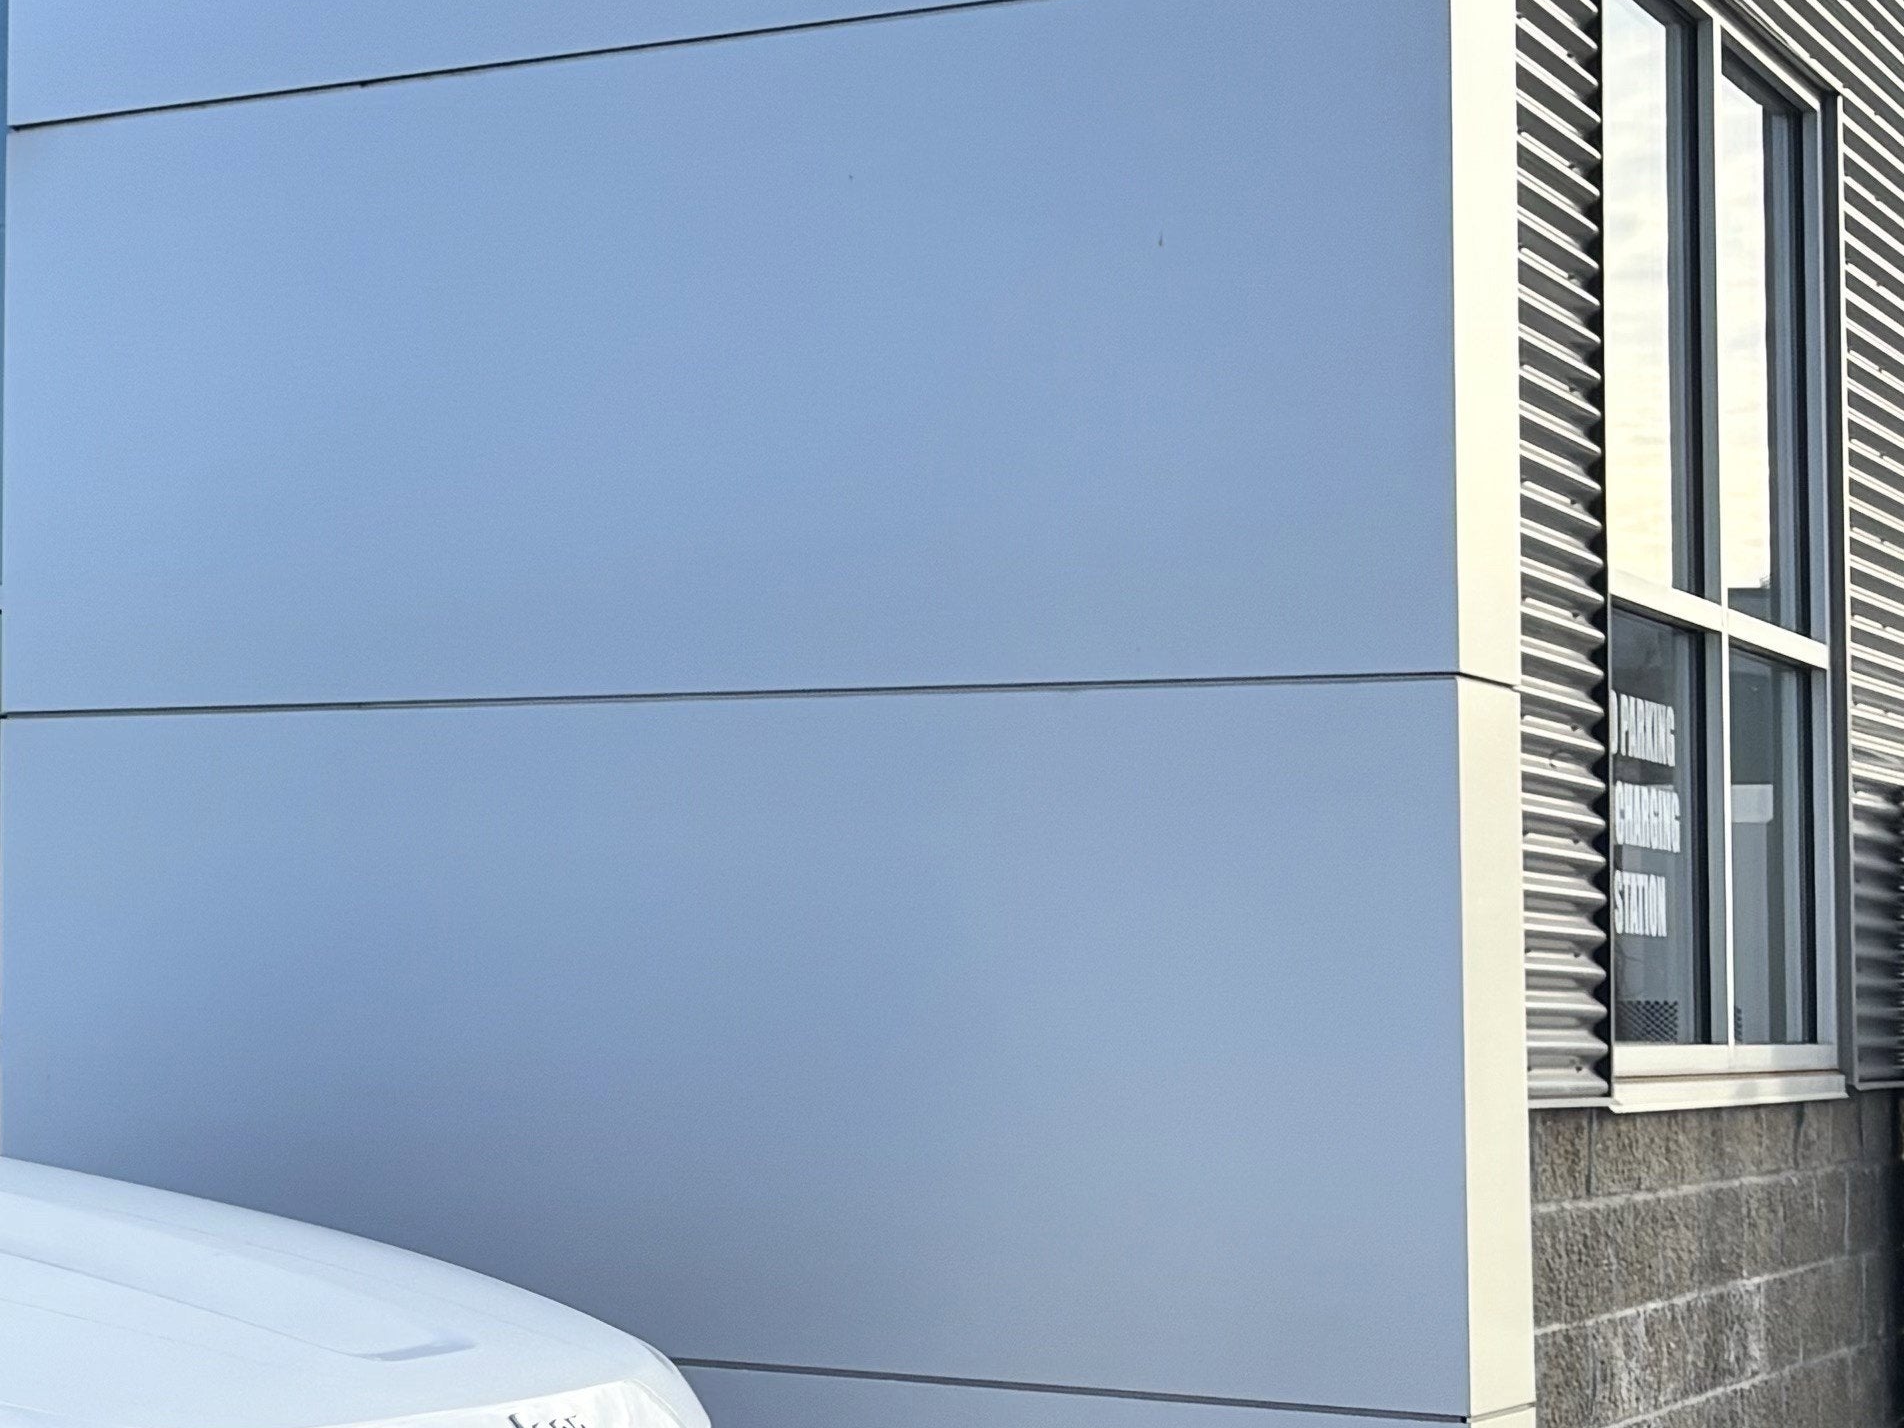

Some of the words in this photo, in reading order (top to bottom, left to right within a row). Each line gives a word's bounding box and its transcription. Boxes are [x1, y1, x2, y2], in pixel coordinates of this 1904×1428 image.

[1620, 693, 1676, 767] PARKING
[1614, 780, 1681, 854] CHARGING
[1613, 869, 1668, 938] STATION
